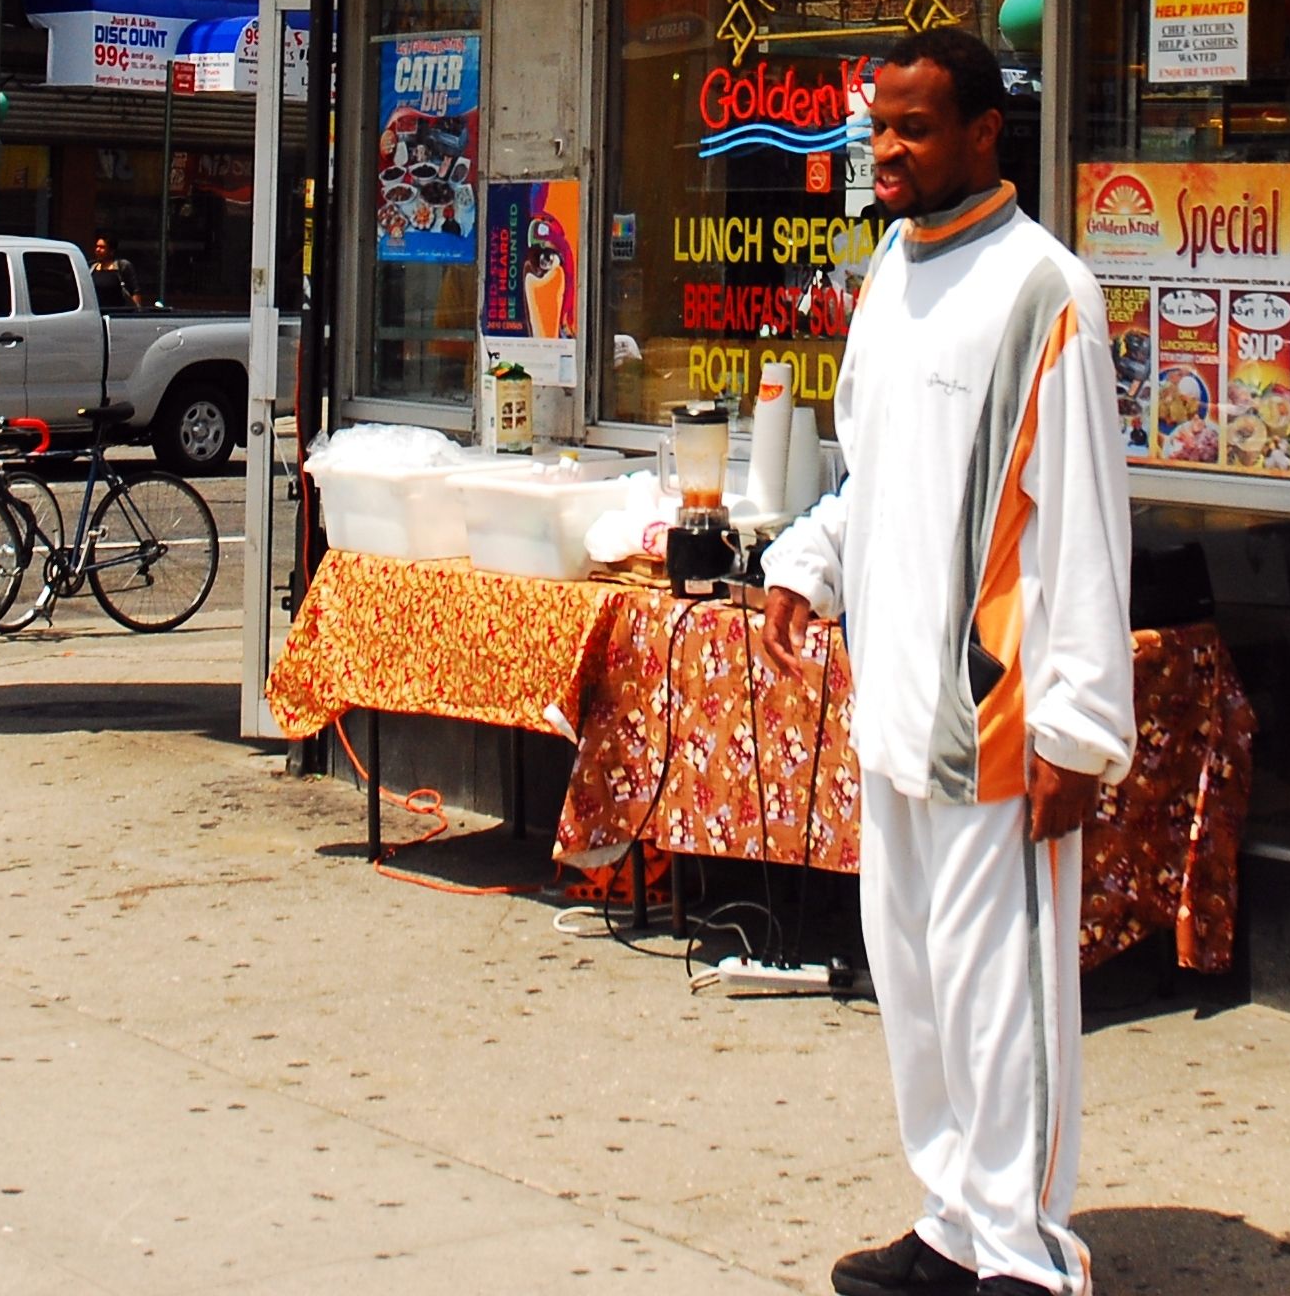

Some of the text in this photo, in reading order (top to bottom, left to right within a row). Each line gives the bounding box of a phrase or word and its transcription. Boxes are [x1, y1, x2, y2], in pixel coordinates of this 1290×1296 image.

[1156, 1, 1245, 18] HELP WANTED
[110, 15, 157, 28] Just A Like
[1162, 23, 1234, 35] CHEF KITCHEN
[95, 25, 167, 48] DISCOUNT
[1158, 37, 1238, 49] HELP & CASHIERS
[95, 44, 154, 71] 99¢ and up
[1178, 52, 1217, 62] WANTED
[95, 74, 120, 86] Everything
[121, 75, 129, 84] For
[142, 78, 154, 86] Home
[394, 55, 463, 93] CATER
[1159, 66, 1236, 77] ENQUIRE WITHIN
[421, 86, 447, 117] big
[700, 61, 840, 129] Golden
[1087, 217, 1160, 236] Golden Krust
[1176, 187, 1281, 268] Special
[674, 217, 762, 263] LUNCH
[509, 204, 518, 319] BE COUNTED
[498, 228, 509, 319] BE HEARD
[1124, 289, 1149, 301] CATER
[684, 283, 803, 333] BREAKFAST
[1109, 311, 1134, 322] EVENT
[1124, 301, 1144, 312] NEXT
[1178, 329, 1199, 340] DAILY
[1238, 332, 1283, 361] SOUP
[689, 345, 750, 395] ROTI
